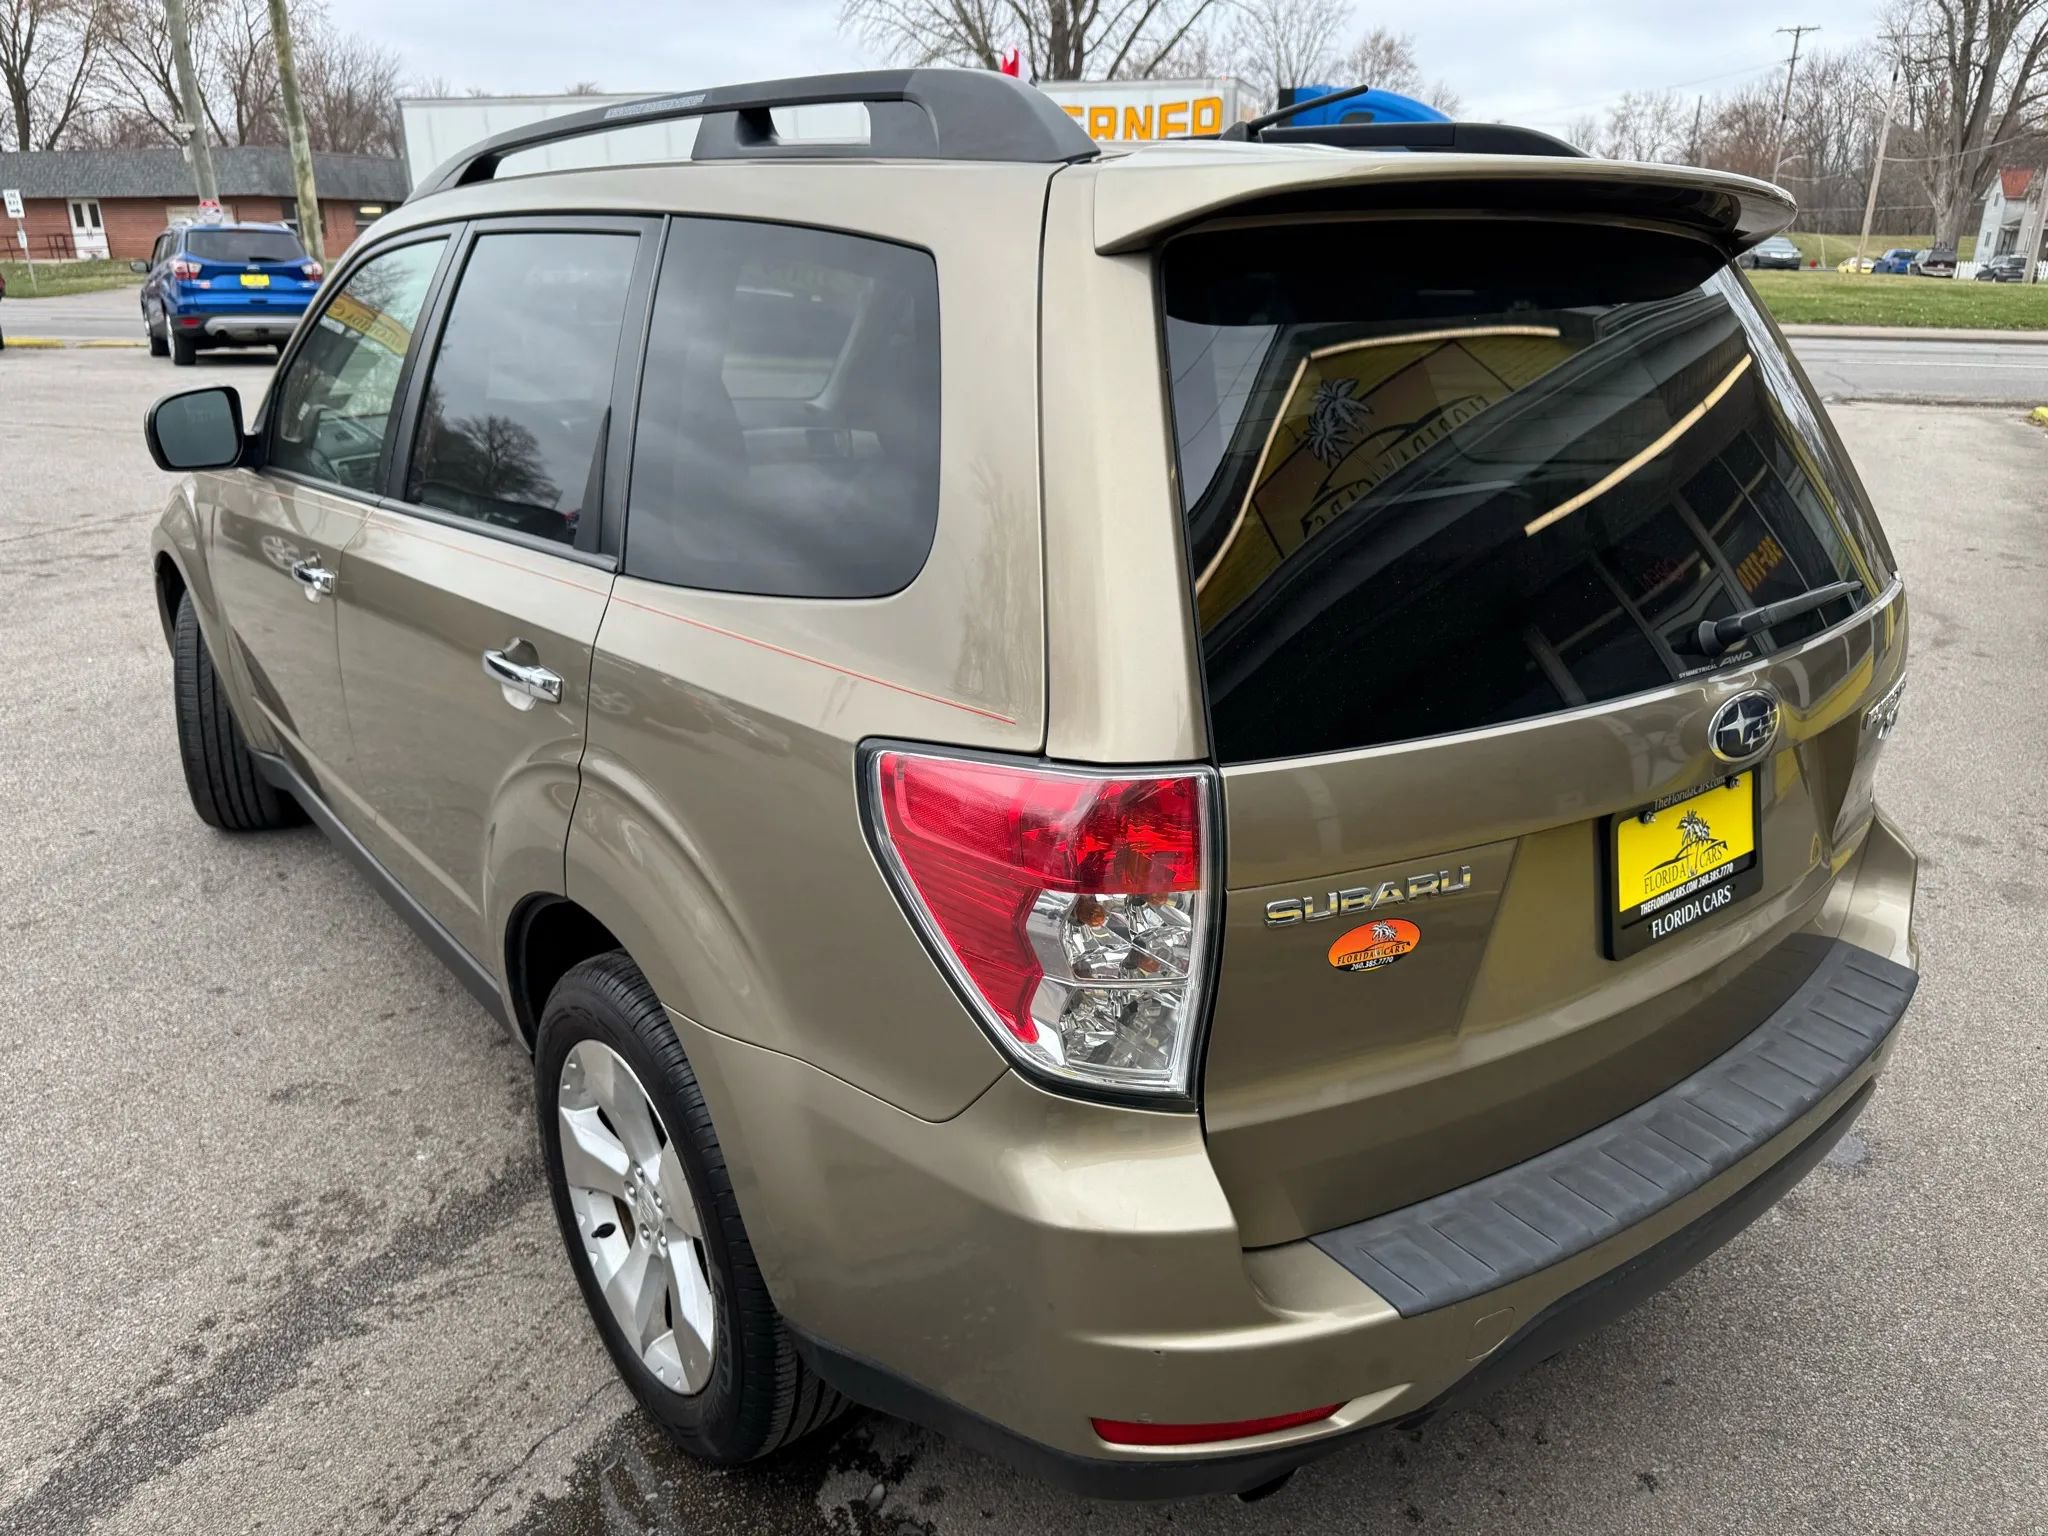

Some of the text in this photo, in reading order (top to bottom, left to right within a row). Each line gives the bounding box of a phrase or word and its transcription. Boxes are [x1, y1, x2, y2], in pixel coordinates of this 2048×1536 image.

[1678, 650, 1753, 679] SYMMETRICAL AWD
[1644, 845, 1723, 894] FLORIDA CARS
[1264, 864, 1472, 928] SUBARU
[1652, 884, 1731, 939] FLORIDA CARS
[1337, 943, 1407, 965] FLORIDA CARS
[1350, 956, 1394, 971] 260.385.7770
